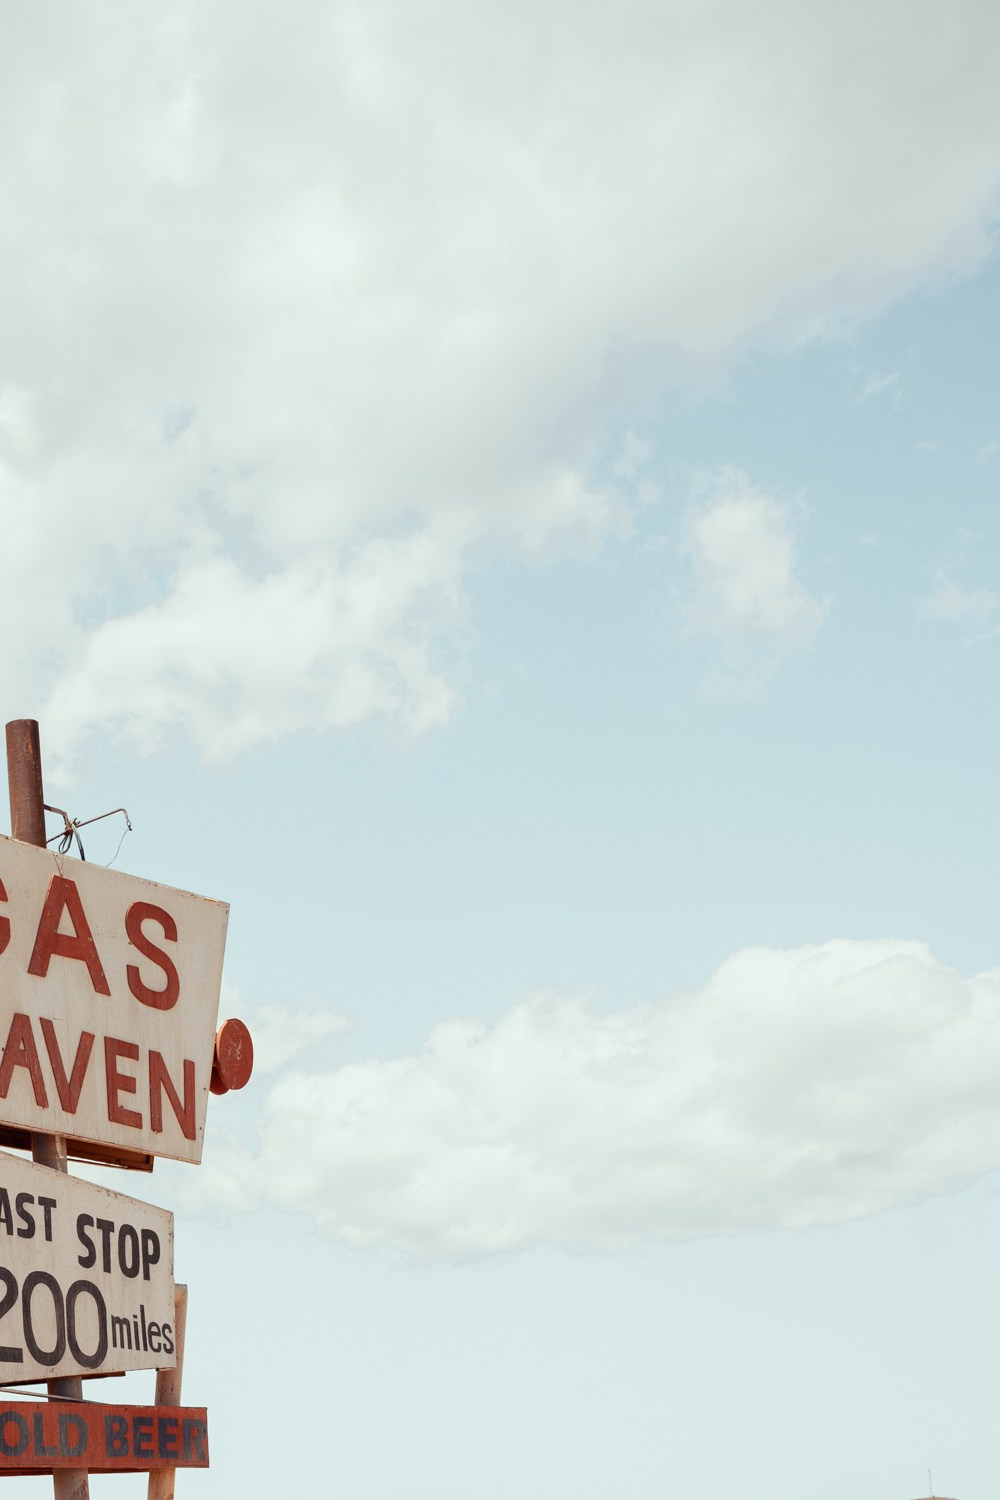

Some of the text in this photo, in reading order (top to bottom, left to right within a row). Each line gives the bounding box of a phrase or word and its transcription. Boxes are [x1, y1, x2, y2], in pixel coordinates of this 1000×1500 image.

[76, 1213, 160, 1281] STOP
[110, 1304, 175, 1355] miles
[103, 1414, 207, 1461] BEER
